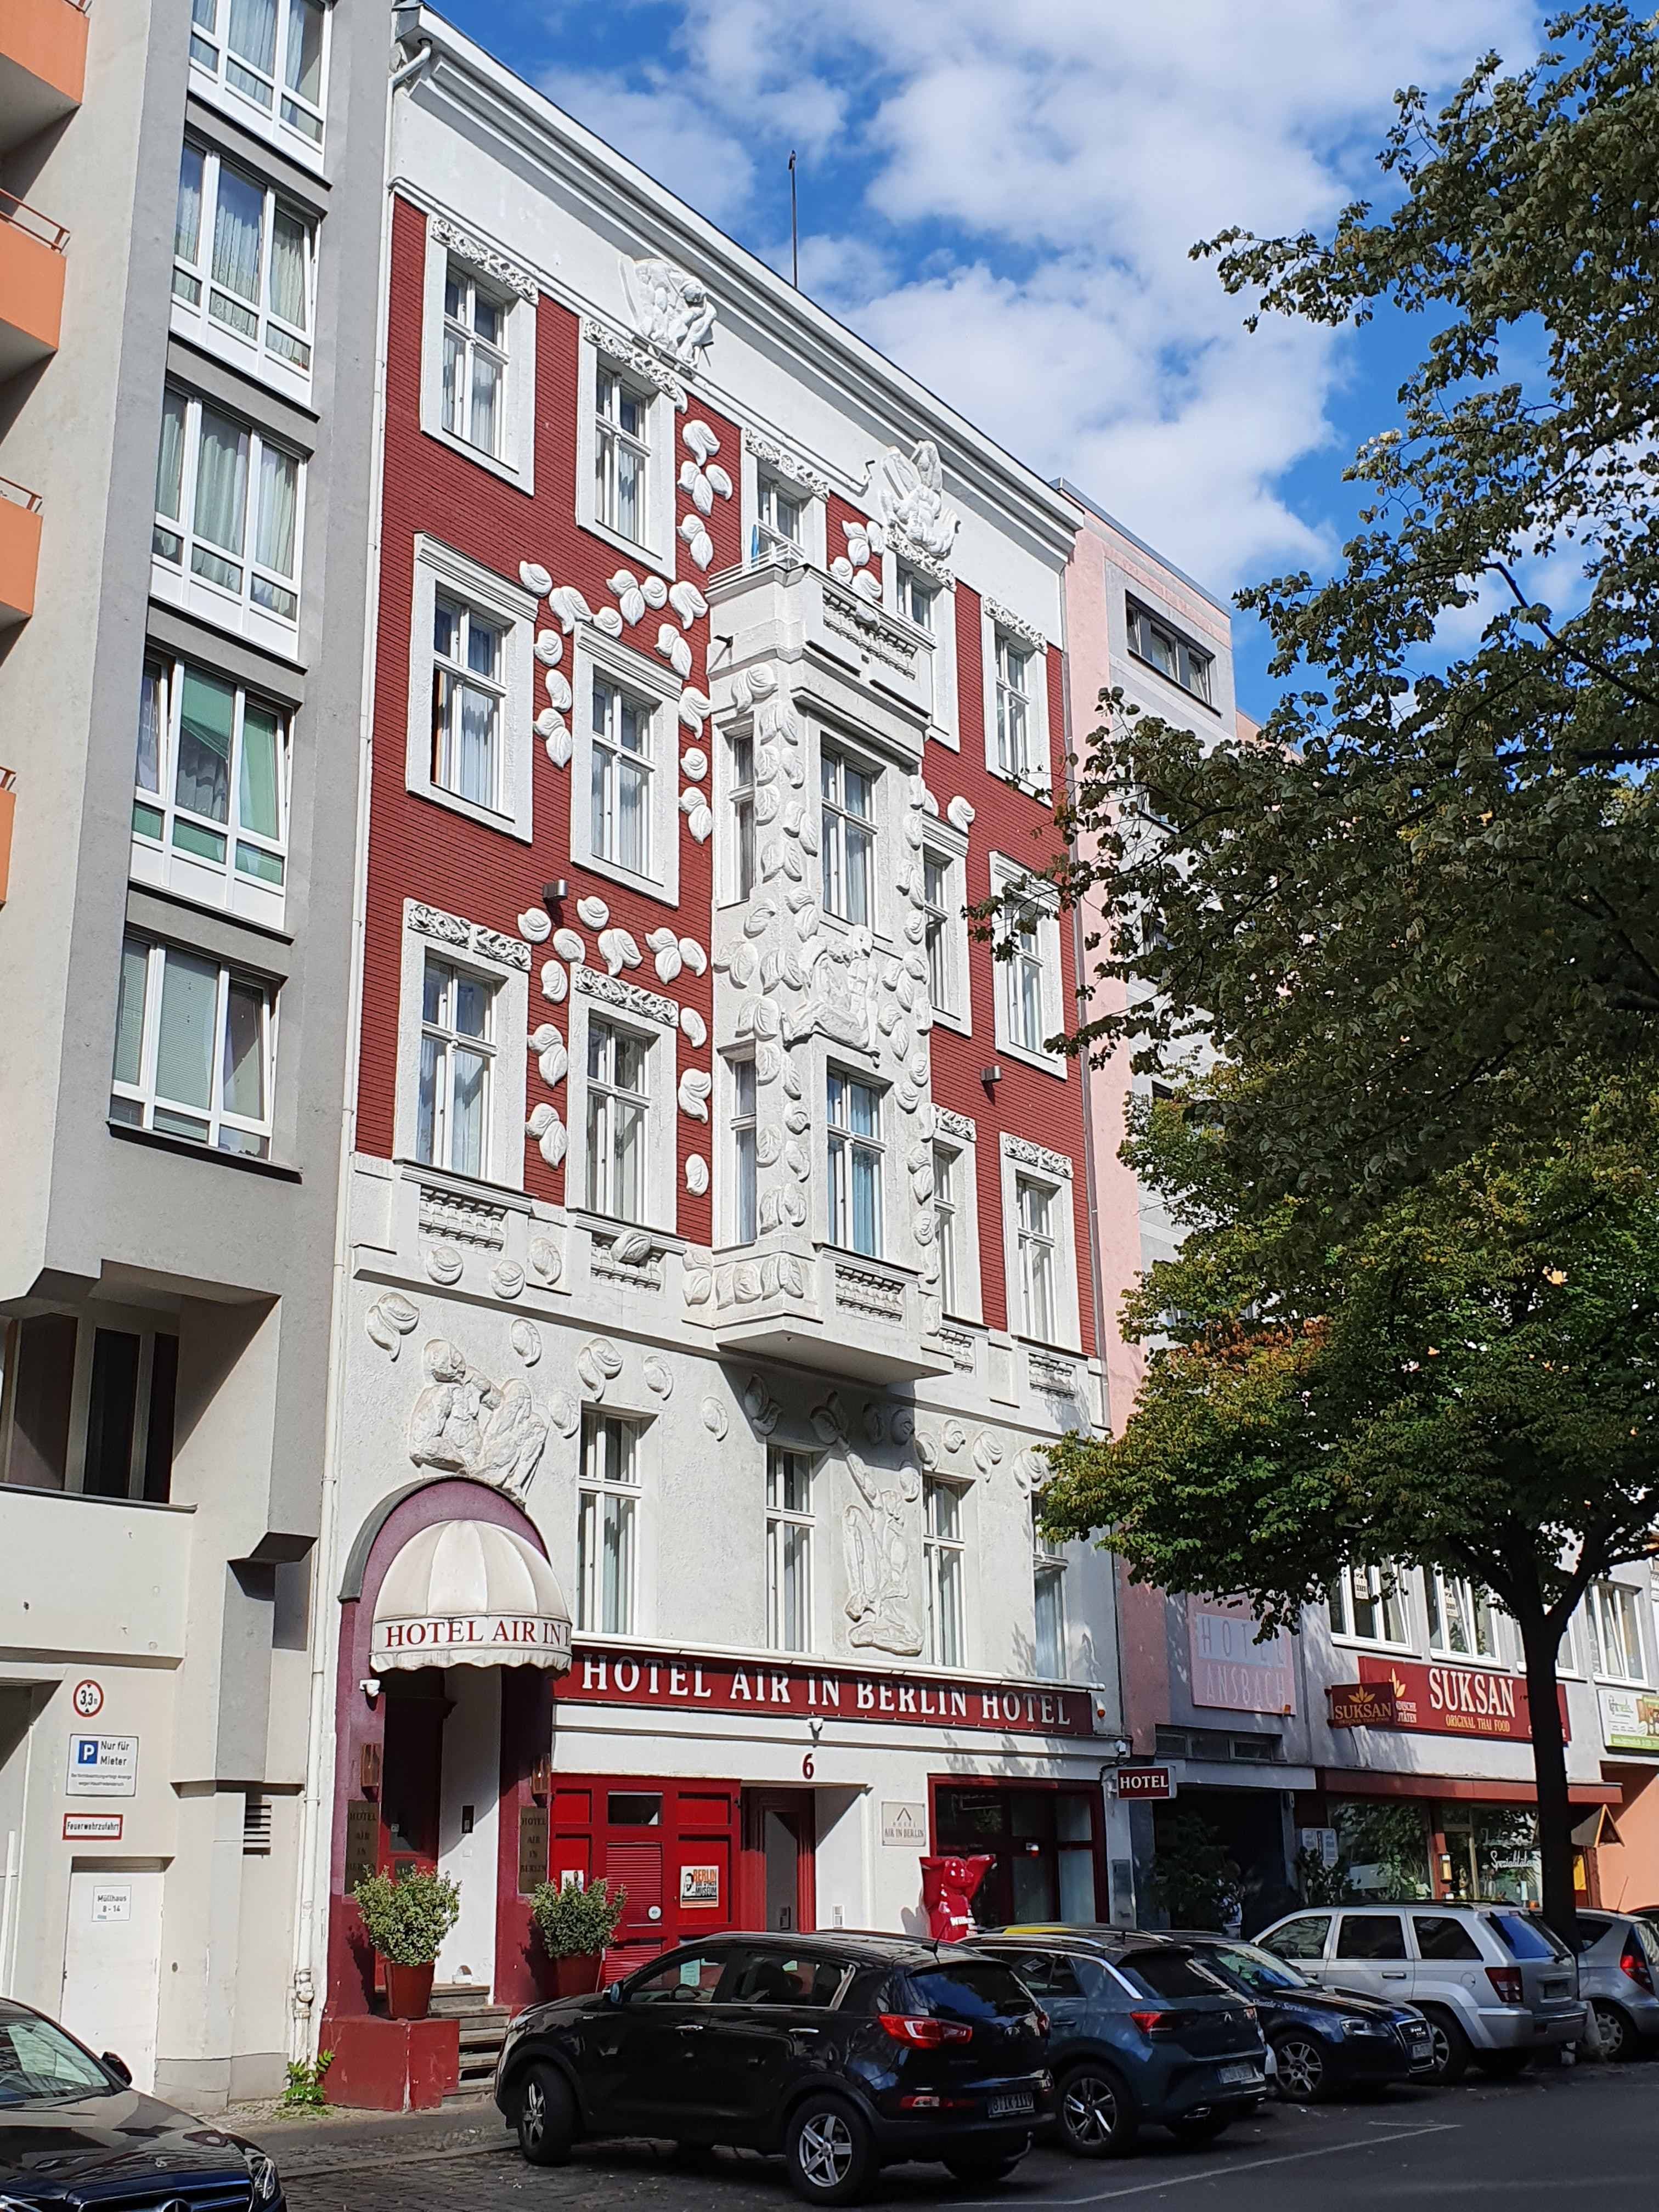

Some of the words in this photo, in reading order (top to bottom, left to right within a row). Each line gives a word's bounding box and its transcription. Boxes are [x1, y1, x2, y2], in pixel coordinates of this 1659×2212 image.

[385, 1620, 484, 1647] HOTEL
[491, 1620, 538, 1644] AIR
[543, 1622, 561, 1645] IN
[582, 1653, 712, 1698] HOTEL
[730, 1666, 791, 1704] AIR
[807, 1672, 840, 1707] IN
[856, 1677, 967, 1717] BERLIN
[981, 1689, 1070, 1725] HOTEL
[1207, 1663, 1285, 1711] ANSBACH
[1429, 1667, 1516, 1718] SUKSAN
[1334, 1702, 1392, 1719] SUKSAN
[1446, 1714, 1476, 1729] ORIGINAL
[1477, 1718, 1492, 1731] THAI
[1493, 1719, 1510, 1733] FOOD
[83, 1743, 95, 1761] P
[100, 1741, 116, 1750] Nur
[117, 1741, 130, 1751] für
[100, 1756, 127, 1766] Mieter
[803, 1753, 814, 1780] 6
[1120, 1775, 1169, 1789] HOTEL
[67, 1821, 119, 1831] Feuerwehrzufahrt
[693, 1869, 717, 1882] BERLIN
